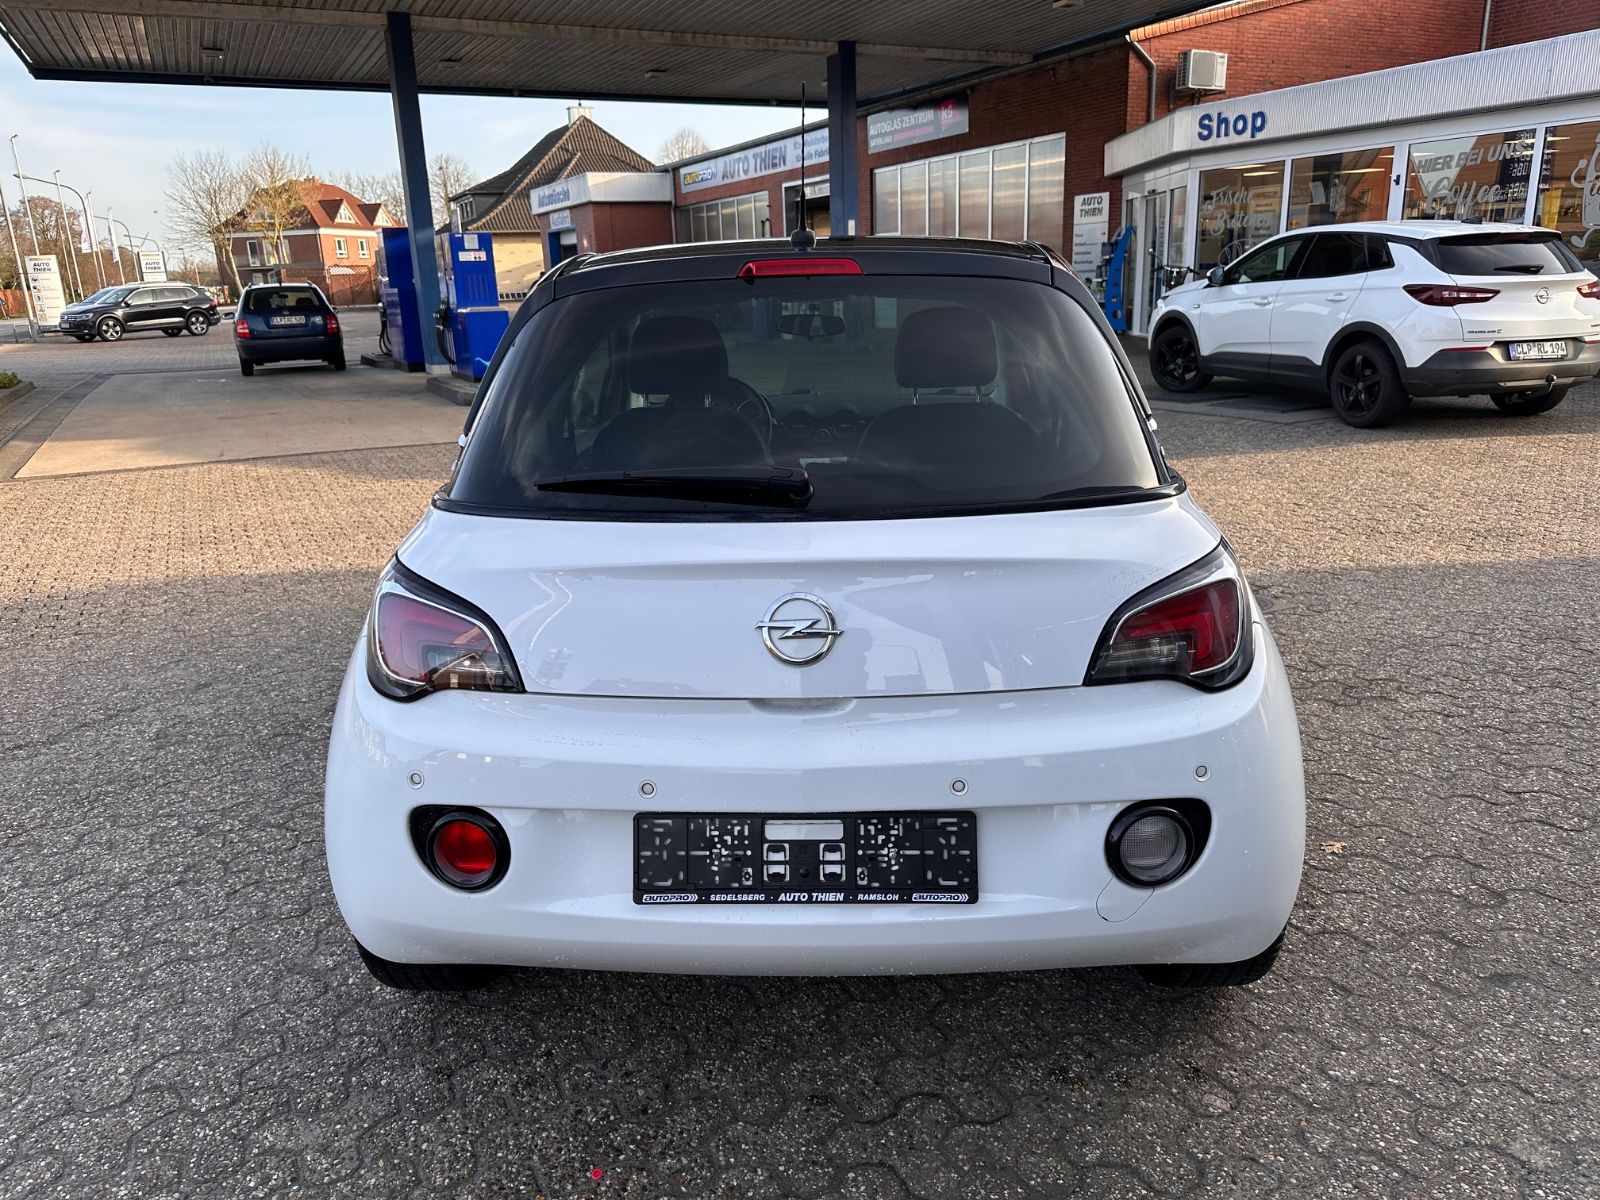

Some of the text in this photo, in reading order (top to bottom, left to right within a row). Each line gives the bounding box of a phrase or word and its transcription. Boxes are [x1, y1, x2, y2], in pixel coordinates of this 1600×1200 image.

[869, 110, 935, 136] AUTOGLAS ZENTRUM
[1198, 111, 1267, 142] Shop
[721, 156, 750, 182] AUTO
[752, 145, 788, 174] THIEN
[1416, 141, 1527, 174] HIER BEI UNS
[1081, 195, 1103, 208] AUTO
[1424, 176, 1504, 220] Coffee
[1079, 207, 1104, 218] THIEN
[1516, 342, 1565, 355] CLP RL 194
[778, 893, 808, 902] AUTO
[811, 893, 844, 902] THIEN
